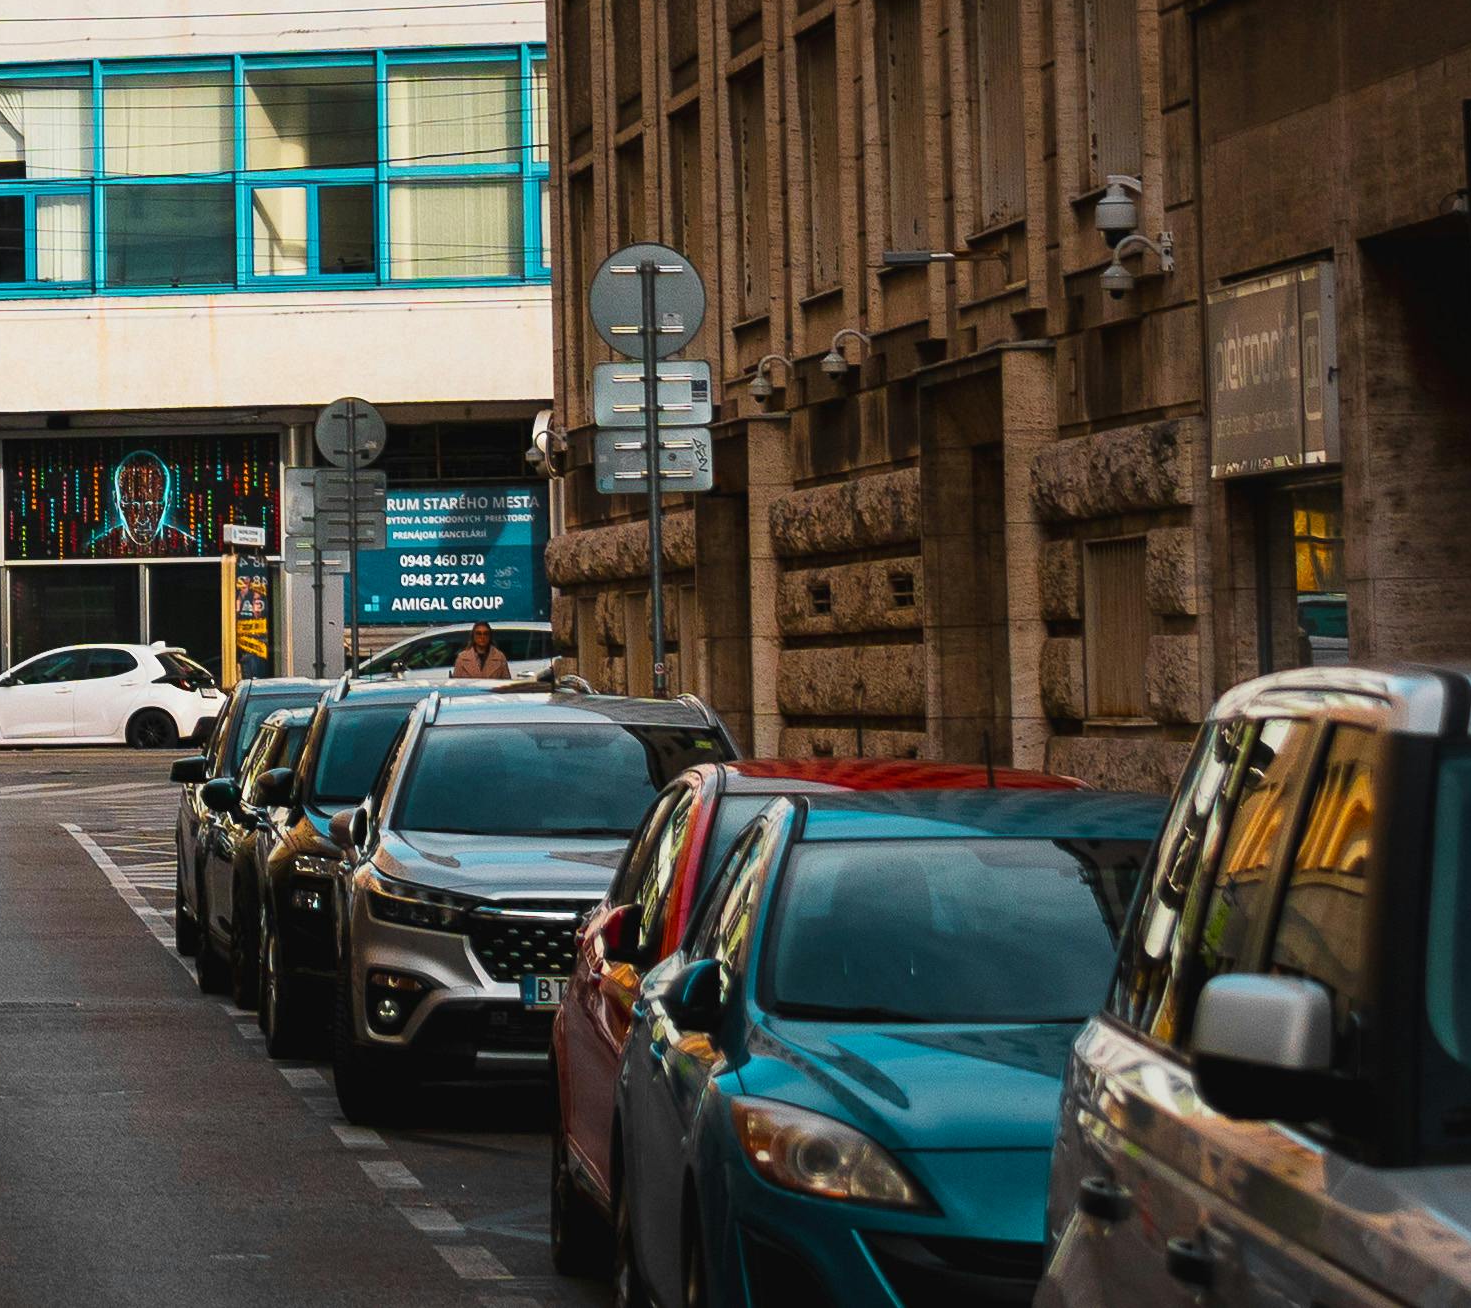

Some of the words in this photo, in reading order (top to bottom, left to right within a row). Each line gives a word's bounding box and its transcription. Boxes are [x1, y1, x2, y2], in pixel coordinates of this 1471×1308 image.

[386, 497, 420, 511] RUM
[423, 493, 488, 511] STARÉHO
[492, 495, 540, 509] MESTA
[414, 515, 421, 524] A
[399, 554, 432, 567] 0948
[433, 554, 457, 567] 460
[460, 553, 485, 566] 870
[400, 573, 432, 586] 0948
[434, 573, 459, 586] 272
[461, 572, 486, 585] 744
[391, 597, 448, 611] AMIGAL
[452, 595, 504, 610] GROUP
